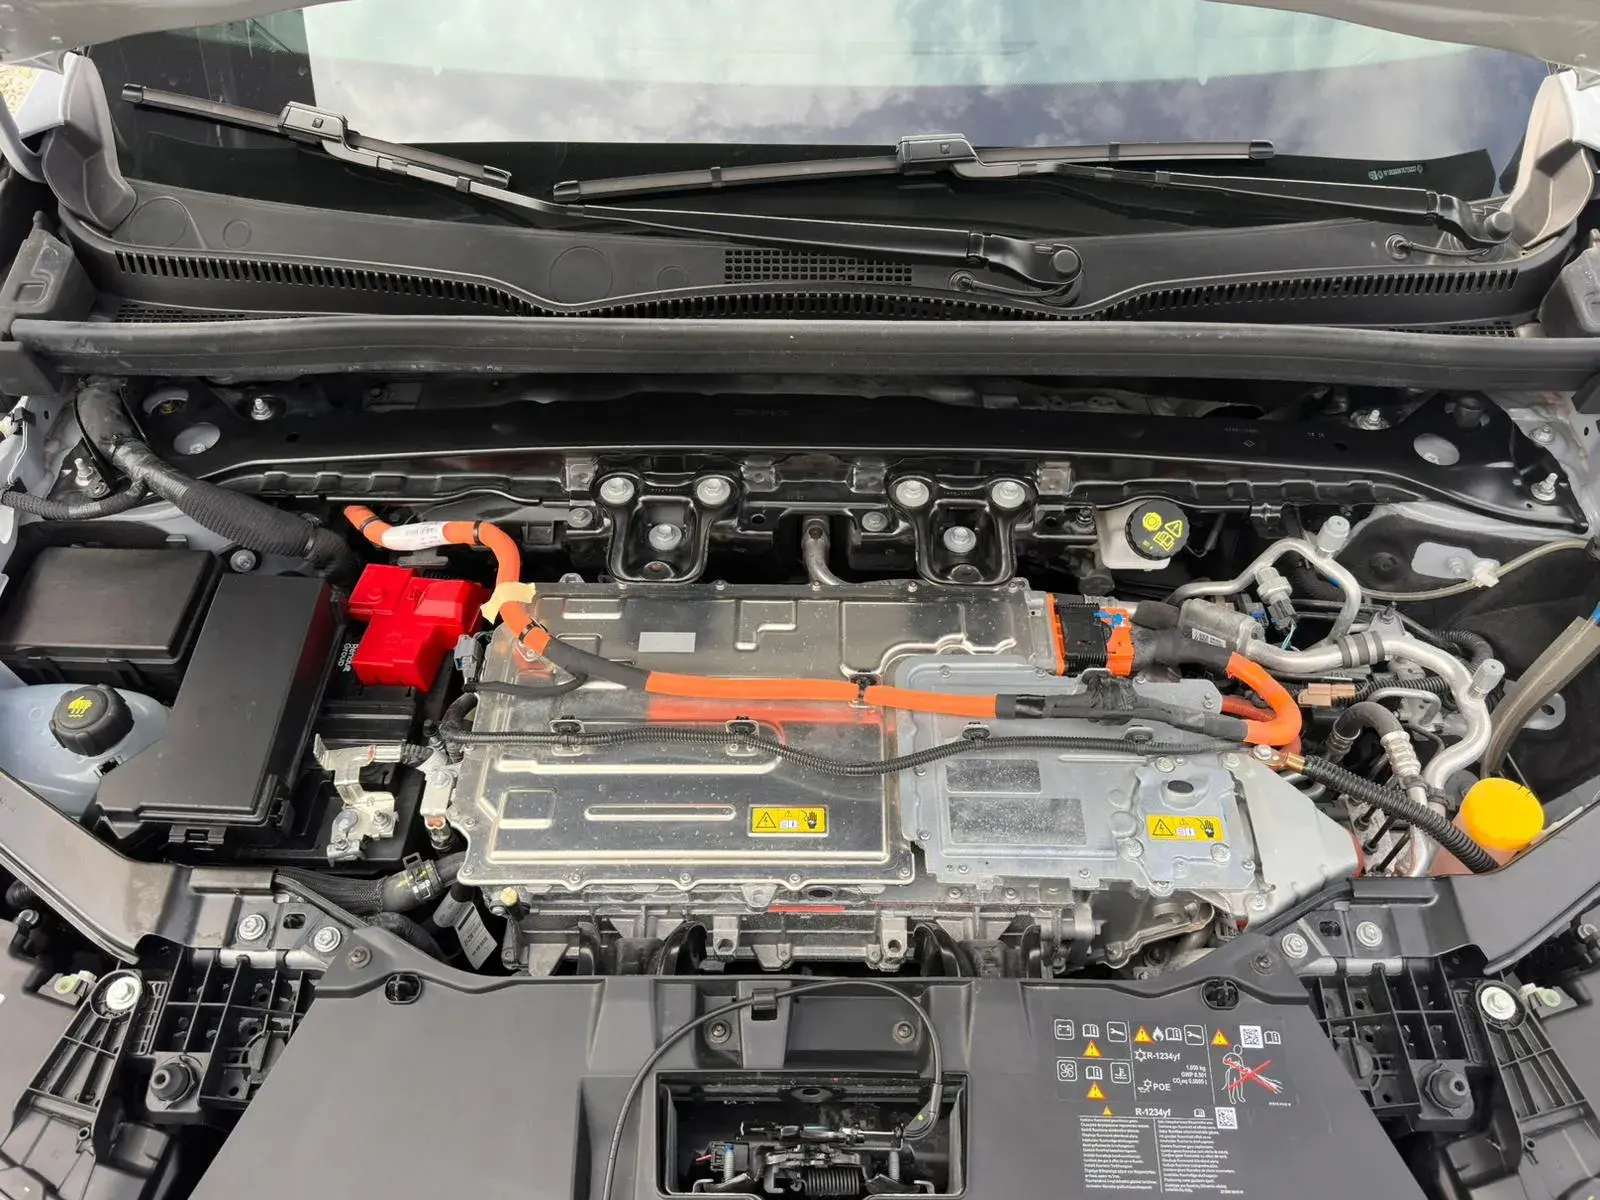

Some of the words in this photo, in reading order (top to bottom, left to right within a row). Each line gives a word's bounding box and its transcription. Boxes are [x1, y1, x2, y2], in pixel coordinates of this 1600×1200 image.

[338, 643, 351, 667] Group
[342, 643, 359, 672] Renault
[1147, 1052, 1181, 1062] R-1234yf
[1153, 1083, 1171, 1091] POE
[1135, 1107, 1171, 1118] R-1234yf
